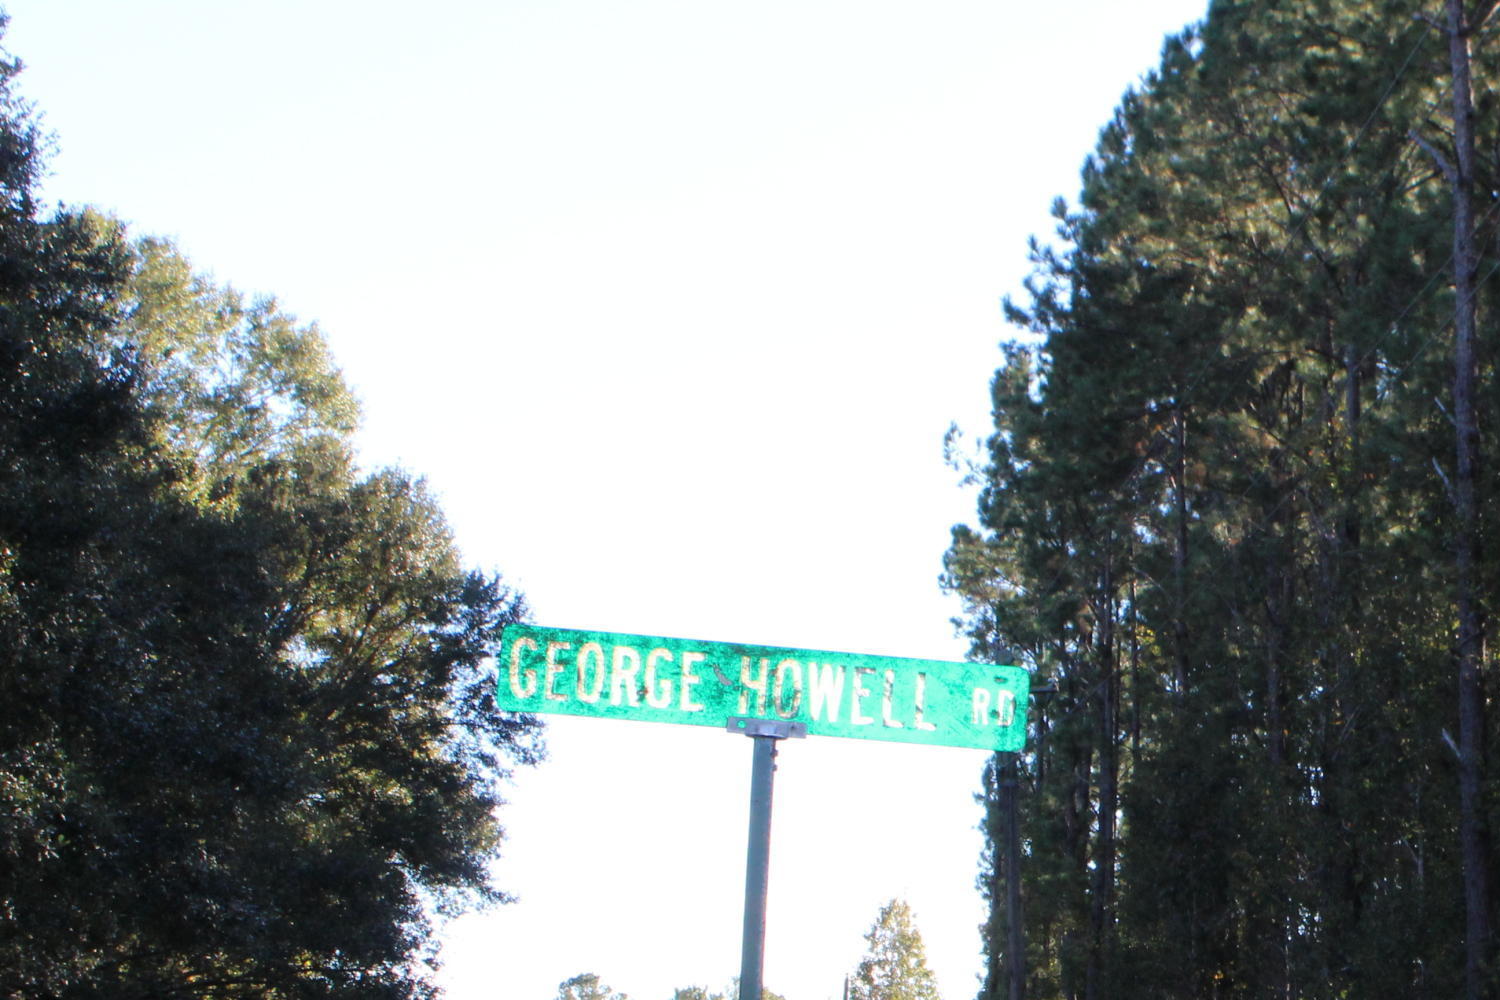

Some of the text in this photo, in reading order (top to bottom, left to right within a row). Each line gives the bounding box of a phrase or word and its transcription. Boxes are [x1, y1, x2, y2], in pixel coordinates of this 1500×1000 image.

[509, 636, 1016, 731] GEORGE HOWELL RD
